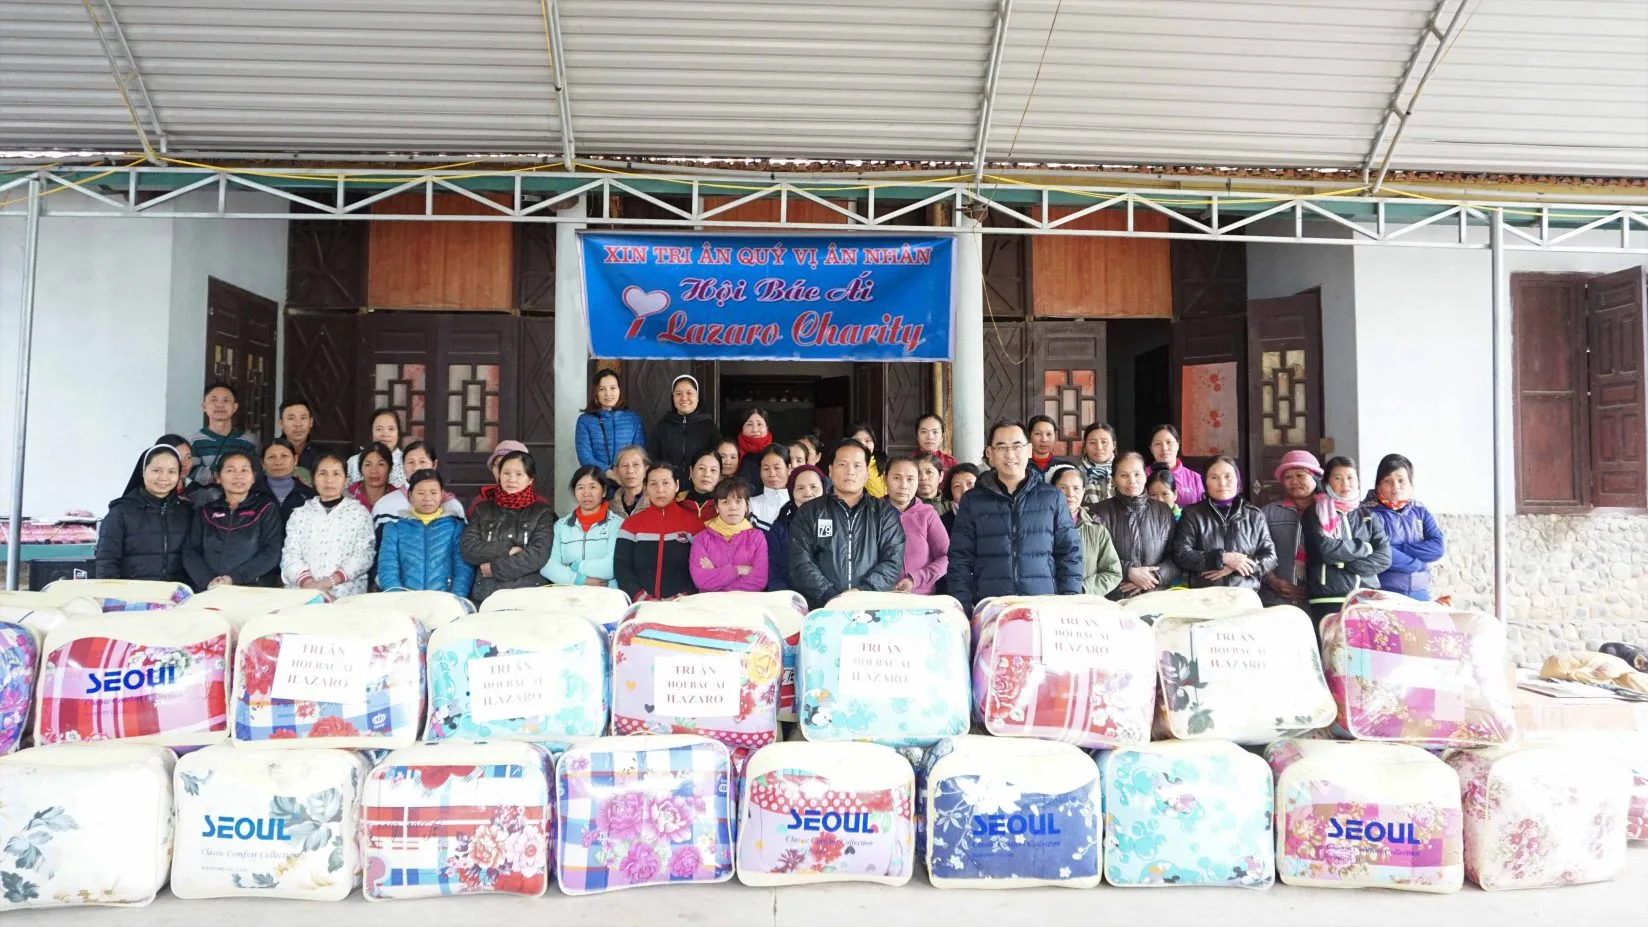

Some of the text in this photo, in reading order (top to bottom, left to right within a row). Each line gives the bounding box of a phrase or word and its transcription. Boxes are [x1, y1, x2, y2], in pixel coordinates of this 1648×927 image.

[604, 241, 934, 270] XIN TRI ÂN QUÝ VỊ ÂN NHÂN
[679, 270, 874, 307] Hội Bác Ái
[657, 310, 783, 346] Lazaro
[791, 309, 926, 352] Charity
[673, 665, 695, 675] TRI
[202, 814, 292, 840] SEOUL
[787, 808, 875, 834] SEOUL
[973, 813, 1061, 836] SEOUL
[1327, 817, 1421, 845] SEOUL
